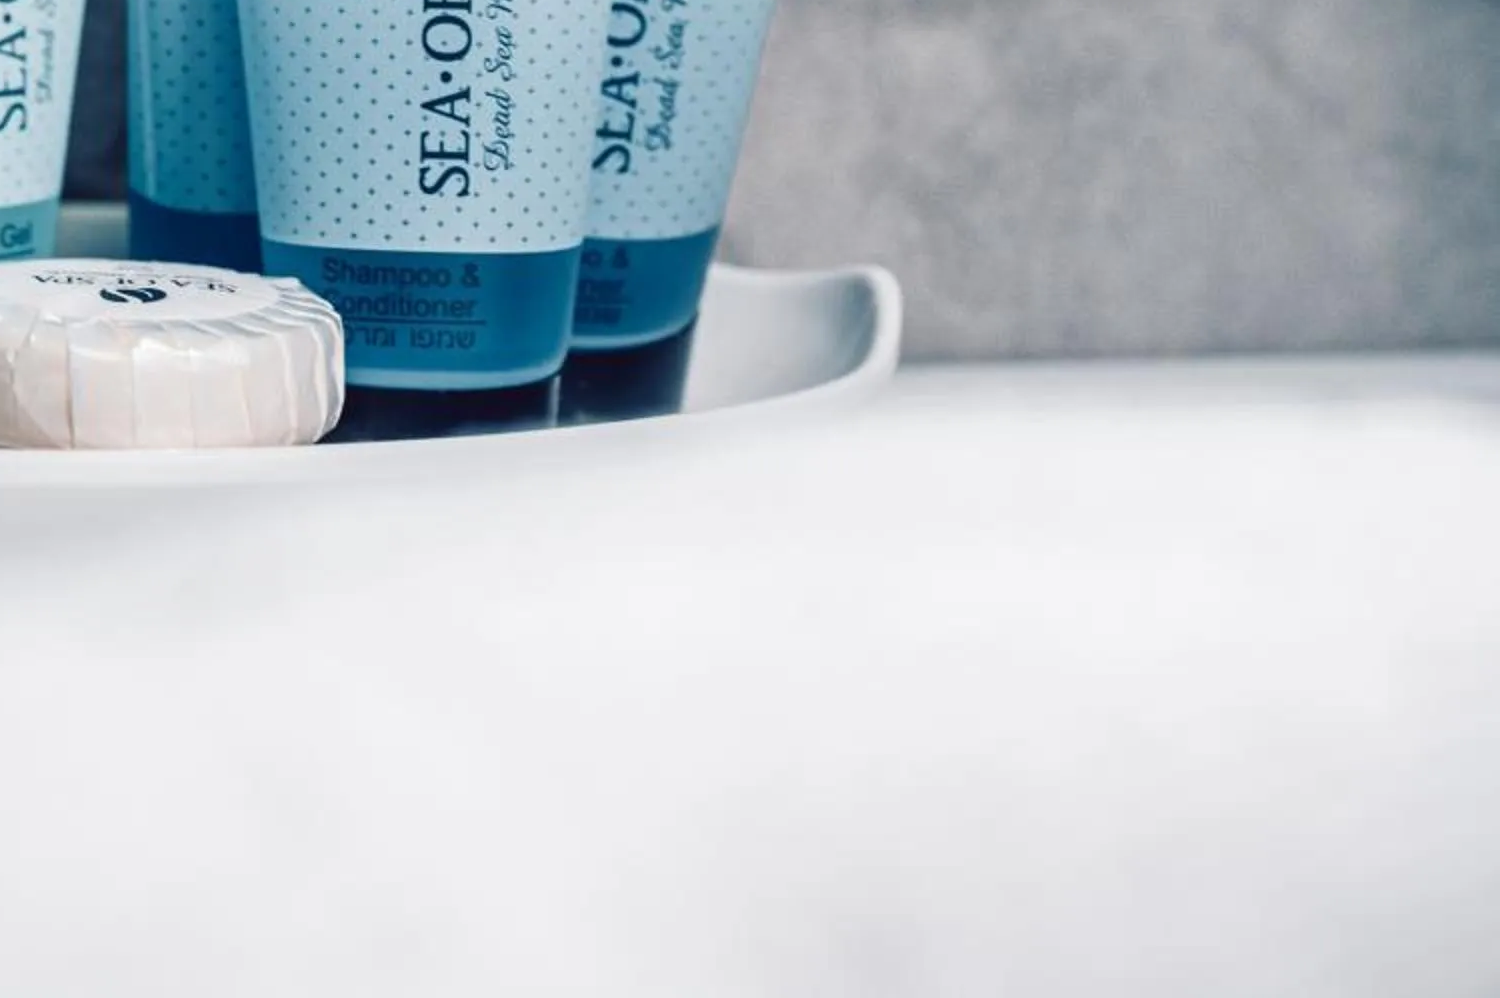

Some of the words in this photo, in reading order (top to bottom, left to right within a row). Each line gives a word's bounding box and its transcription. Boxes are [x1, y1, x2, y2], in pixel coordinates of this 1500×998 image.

[484, 26, 513, 81] Sea
[649, 20, 686, 69] Sea
[483, 88, 512, 172] Dead
[642, 78, 677, 152] Dead
[322, 256, 452, 289] Shampoo
[461, 261, 481, 288] &
[410, 328, 476, 350] שמפו
